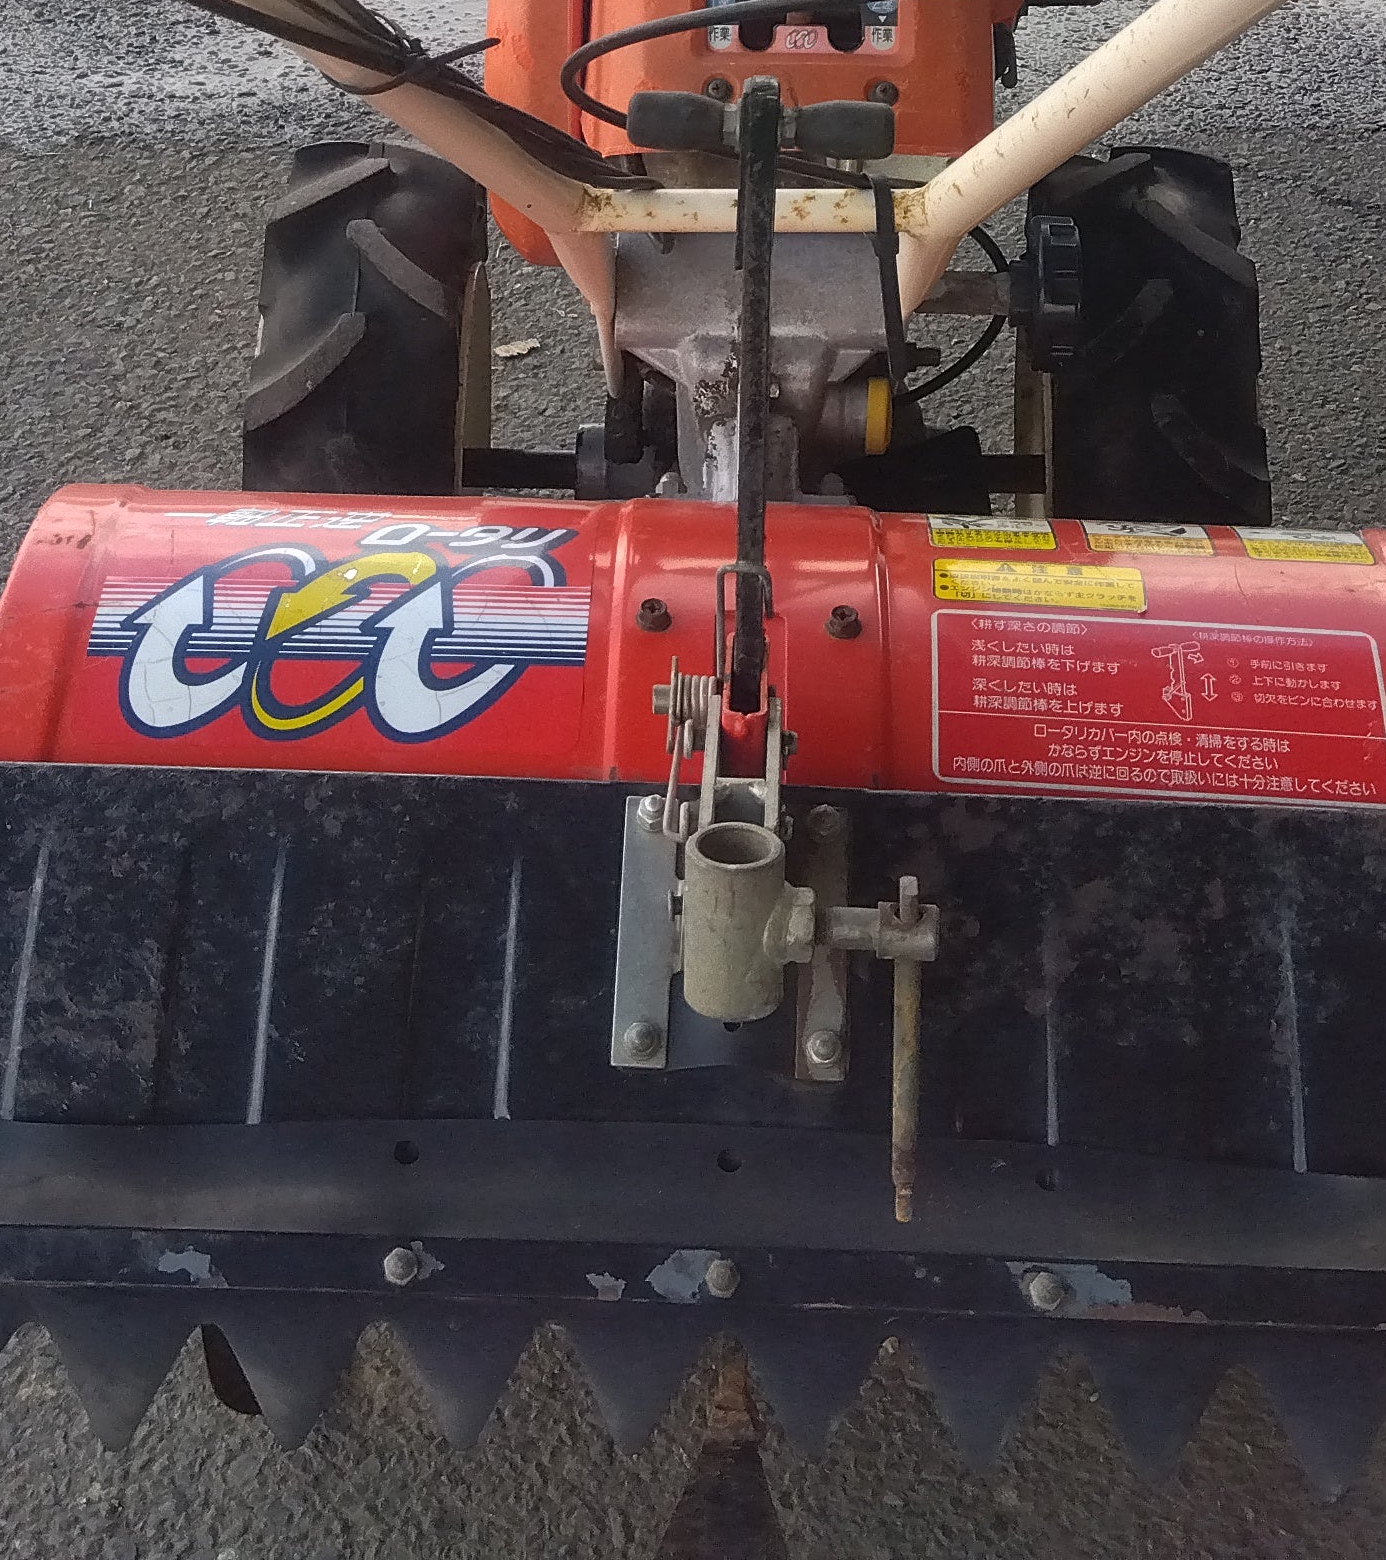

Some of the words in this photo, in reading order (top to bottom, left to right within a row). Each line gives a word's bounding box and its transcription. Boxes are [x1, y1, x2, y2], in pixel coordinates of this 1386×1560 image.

[361, 522, 567, 549] ロータリ
[971, 639, 1076, 656] 浅くしたい時は
[971, 654, 1121, 675] 耕深調節棒を下げます
[1250, 659, 1329, 673] 手前に引きます
[972, 678, 1078, 696] 深くしたい時は
[1253, 676, 1342, 691] 上下に動かします
[973, 695, 1124, 718] 耕深調節棒を上げます
[1048, 743, 1280, 771] かならずエンジンを停止してください
[953, 756, 1378, 797] 内側の爪と外側の爪は逆に回るので取扱いには十分注意してください
